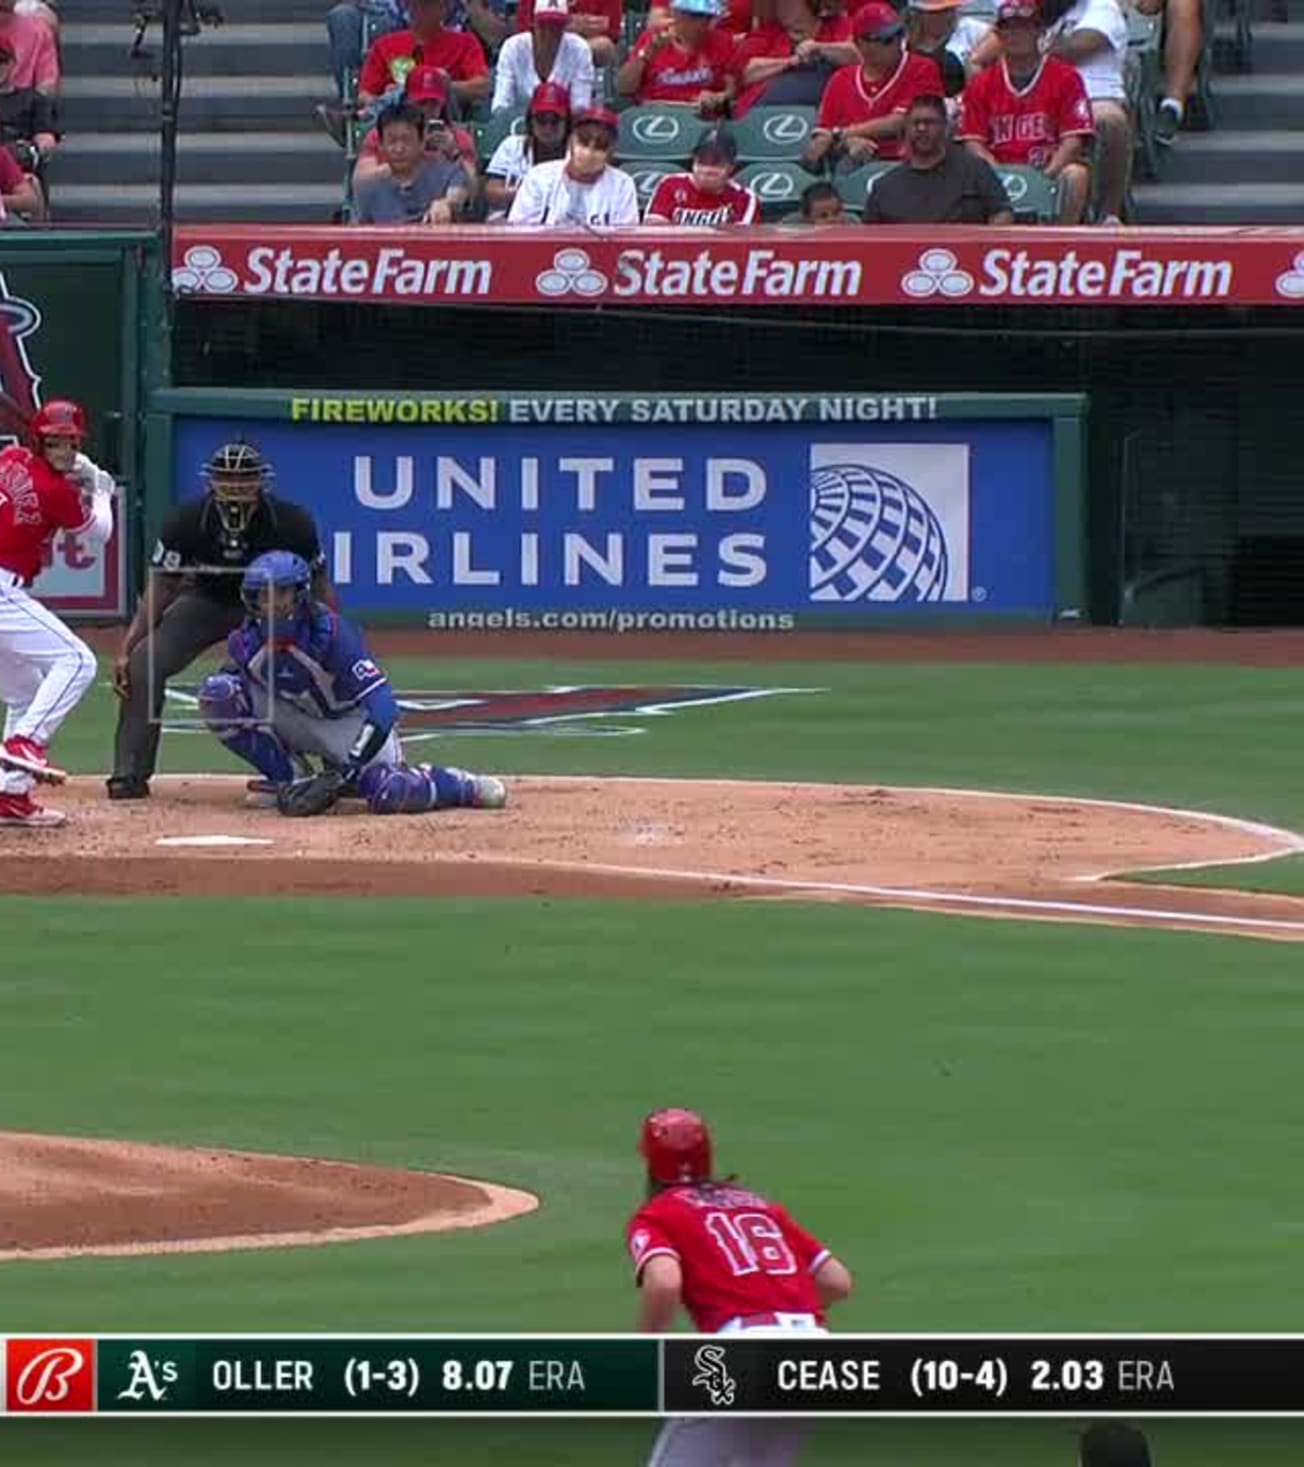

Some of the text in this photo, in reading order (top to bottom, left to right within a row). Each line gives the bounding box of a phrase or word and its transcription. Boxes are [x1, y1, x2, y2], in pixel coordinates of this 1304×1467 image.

[291, 398, 937, 422] FIREWORKS! EVERY SATURDAY NIGHT!
[353, 454, 768, 512] UNITED
[333, 530, 768, 587] IRLINES
[427, 608, 796, 632] angels.com/promotions
[704, 1211, 798, 1276] 16
